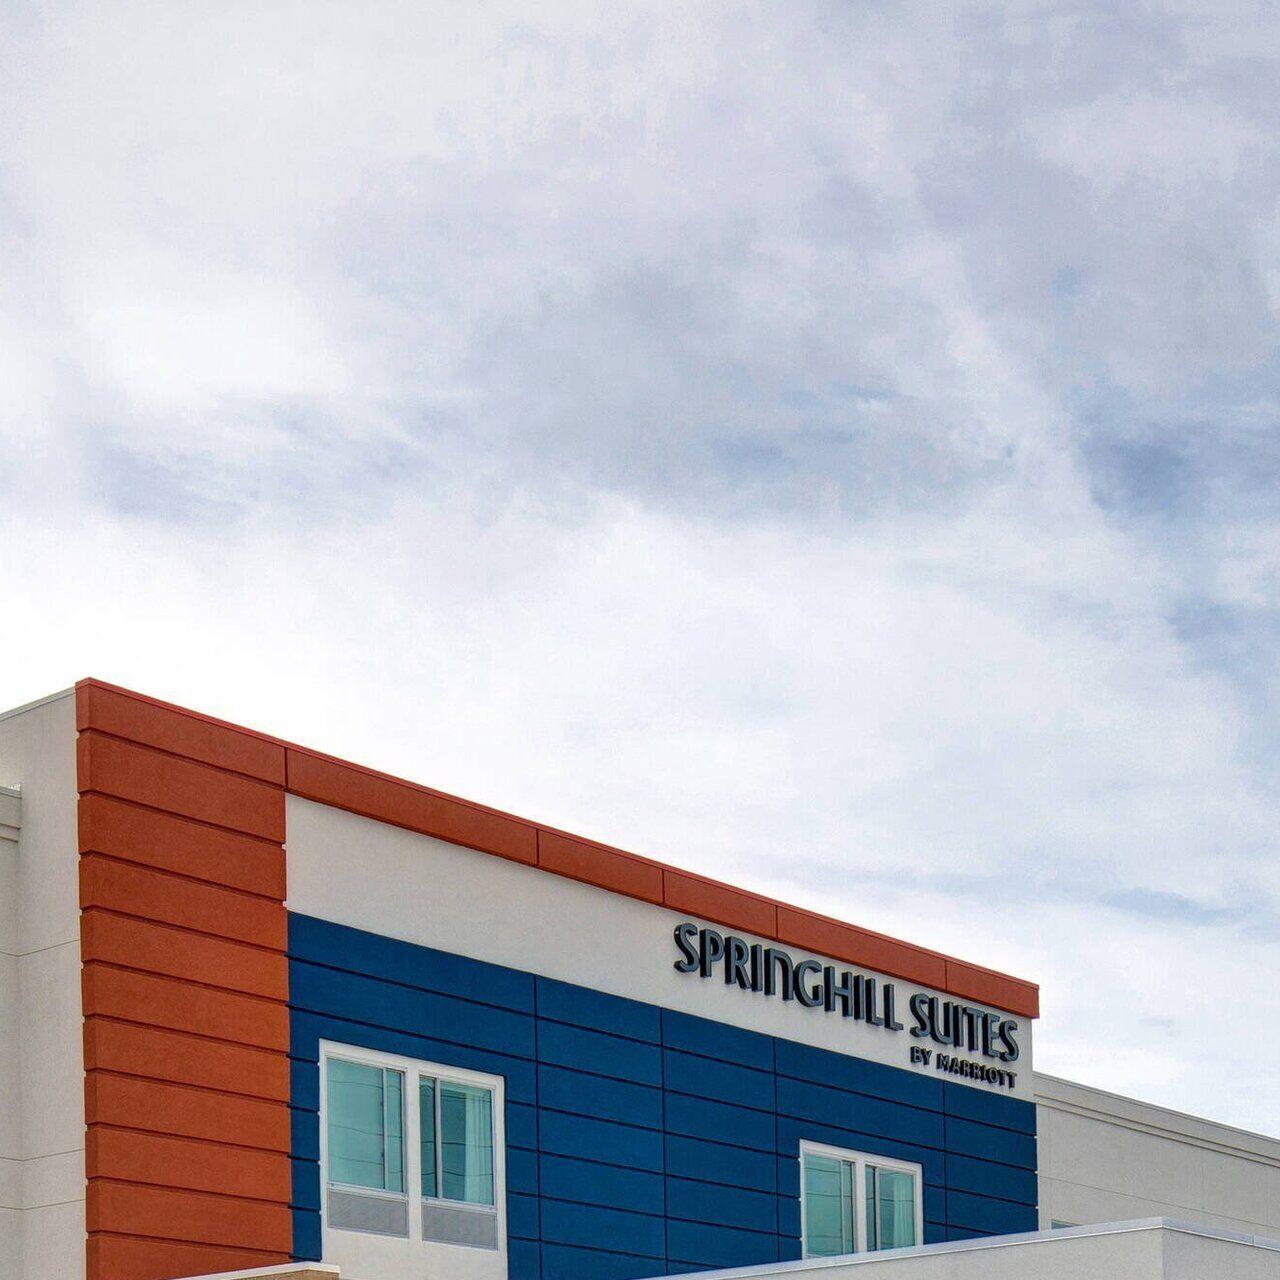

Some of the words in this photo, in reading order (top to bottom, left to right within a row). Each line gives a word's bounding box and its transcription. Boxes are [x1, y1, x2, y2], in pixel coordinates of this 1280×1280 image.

[673, 922, 904, 1031] SPRINGHILL
[909, 993, 1019, 1062] SUITES
[910, 1046, 932, 1065] BY
[936, 1053, 1017, 1088] MARRIOTT
